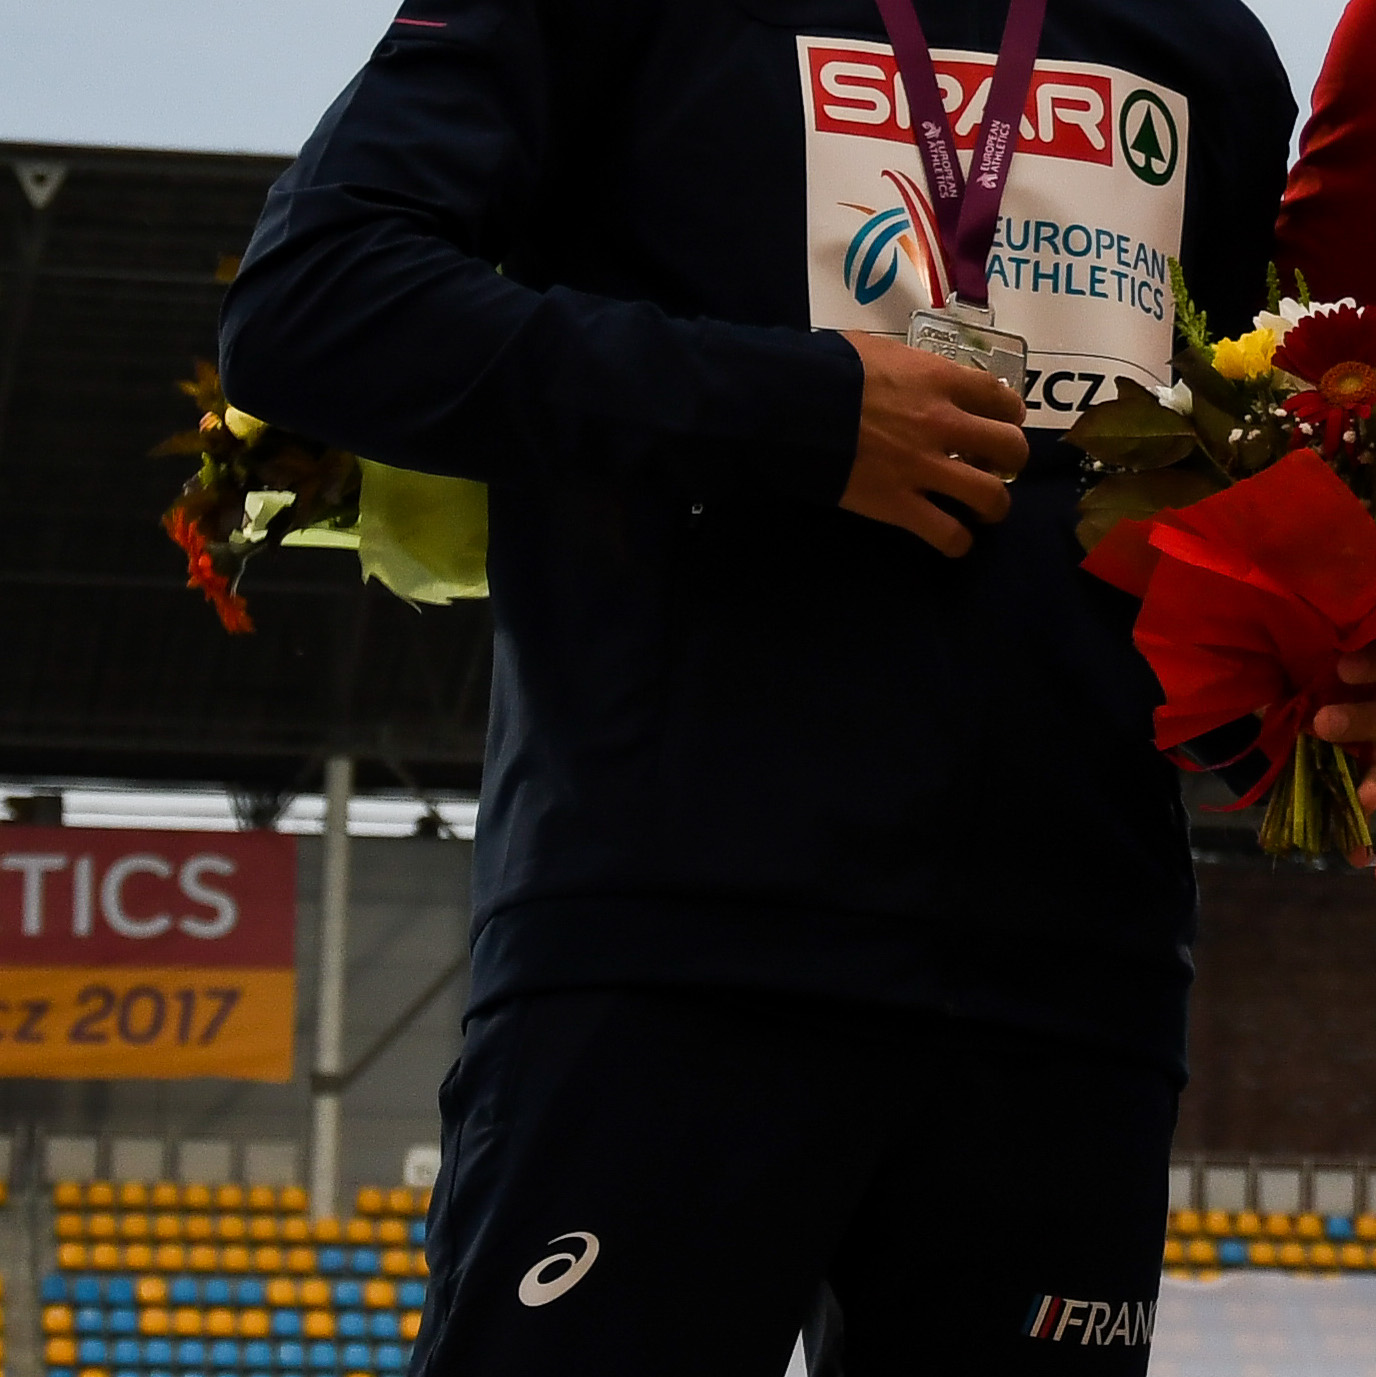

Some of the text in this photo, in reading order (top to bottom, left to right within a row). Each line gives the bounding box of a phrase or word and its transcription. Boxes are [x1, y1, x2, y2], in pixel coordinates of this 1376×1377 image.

[927, 140, 949, 199] ATHLETICS
[936, 139, 958, 198] EUROPEAN
[980, 119, 1001, 172] EUROPEAN
[990, 122, 1011, 173] ATHLETICS
[986, 254, 1164, 321] ATHLETICS
[67, 984, 242, 1046] 2017
